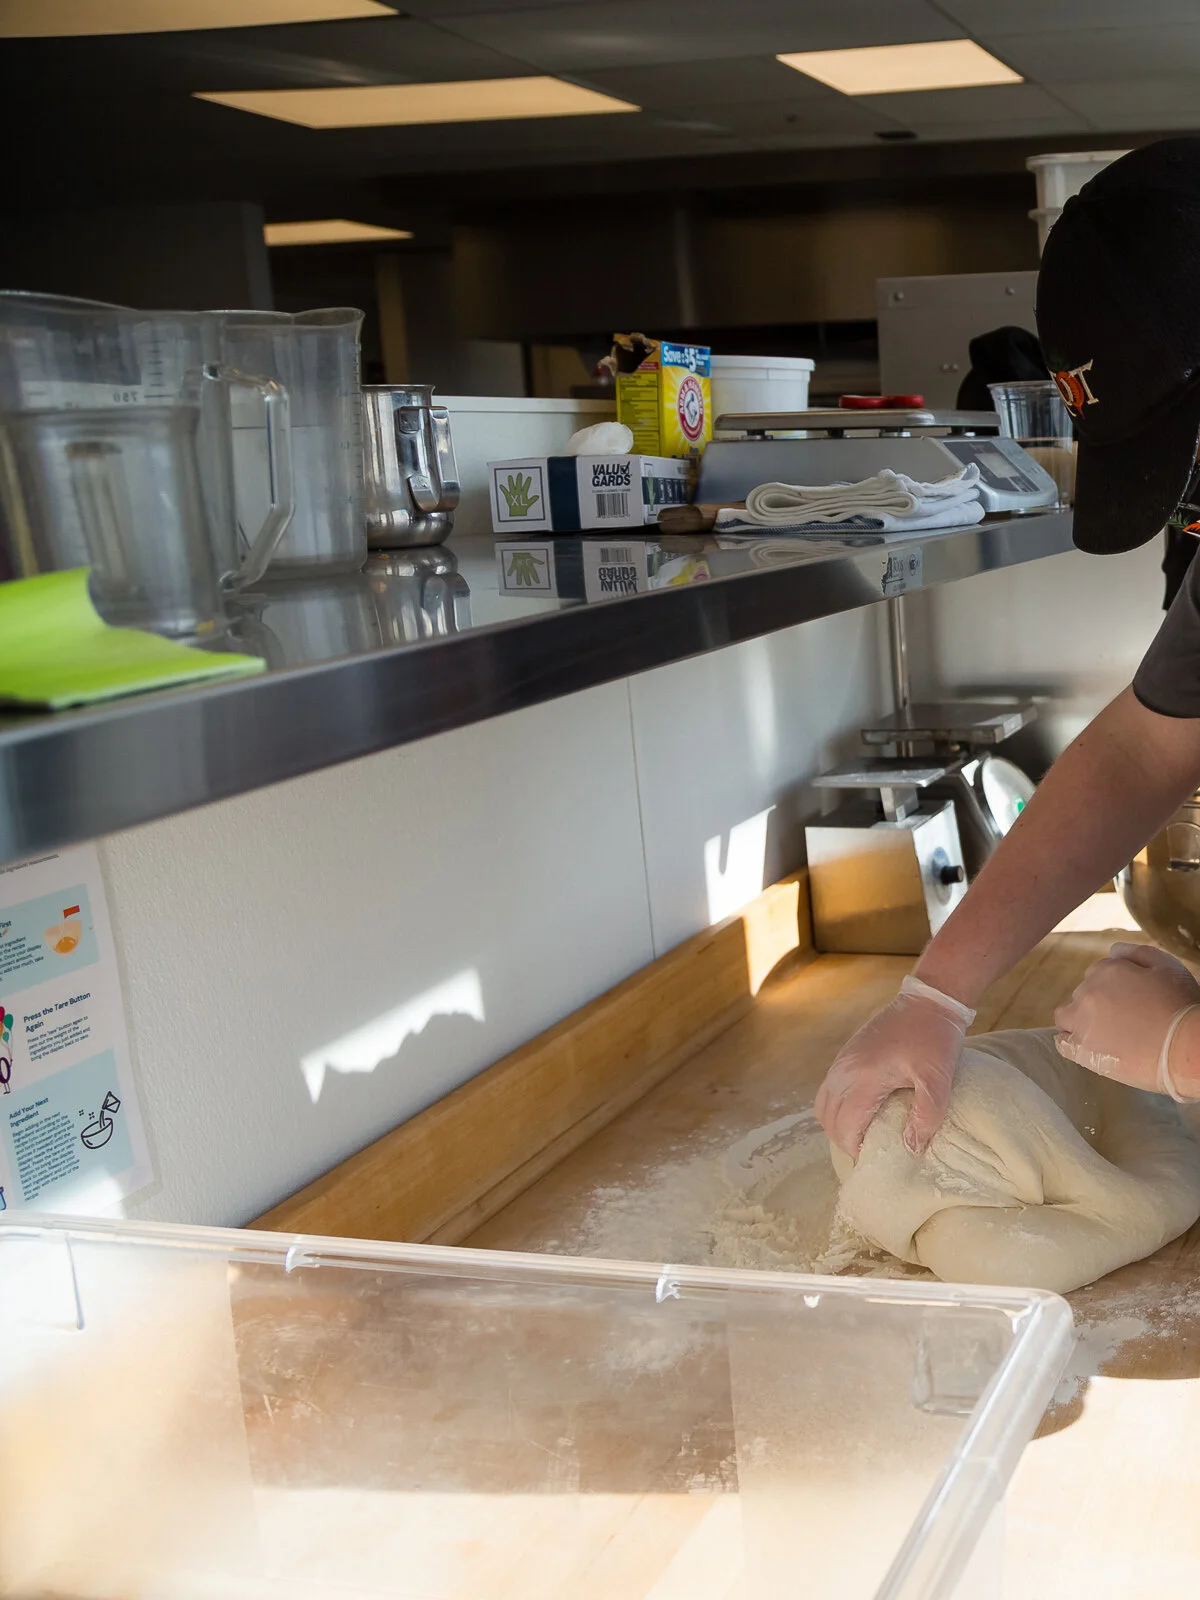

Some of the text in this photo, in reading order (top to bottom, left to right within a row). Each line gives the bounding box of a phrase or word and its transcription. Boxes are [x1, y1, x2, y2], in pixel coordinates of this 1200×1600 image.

[664, 346, 681, 363] Save
[592, 463, 620, 476] VALU
[592, 475, 631, 487] GARDS
[511, 495, 528, 506] XL
[24, 993, 90, 1023] Press the Tare Button
[26, 1021, 44, 1032] Again
[10, 1098, 48, 1119] Add Your Next
[10, 1111, 39, 1128] Ingredient
